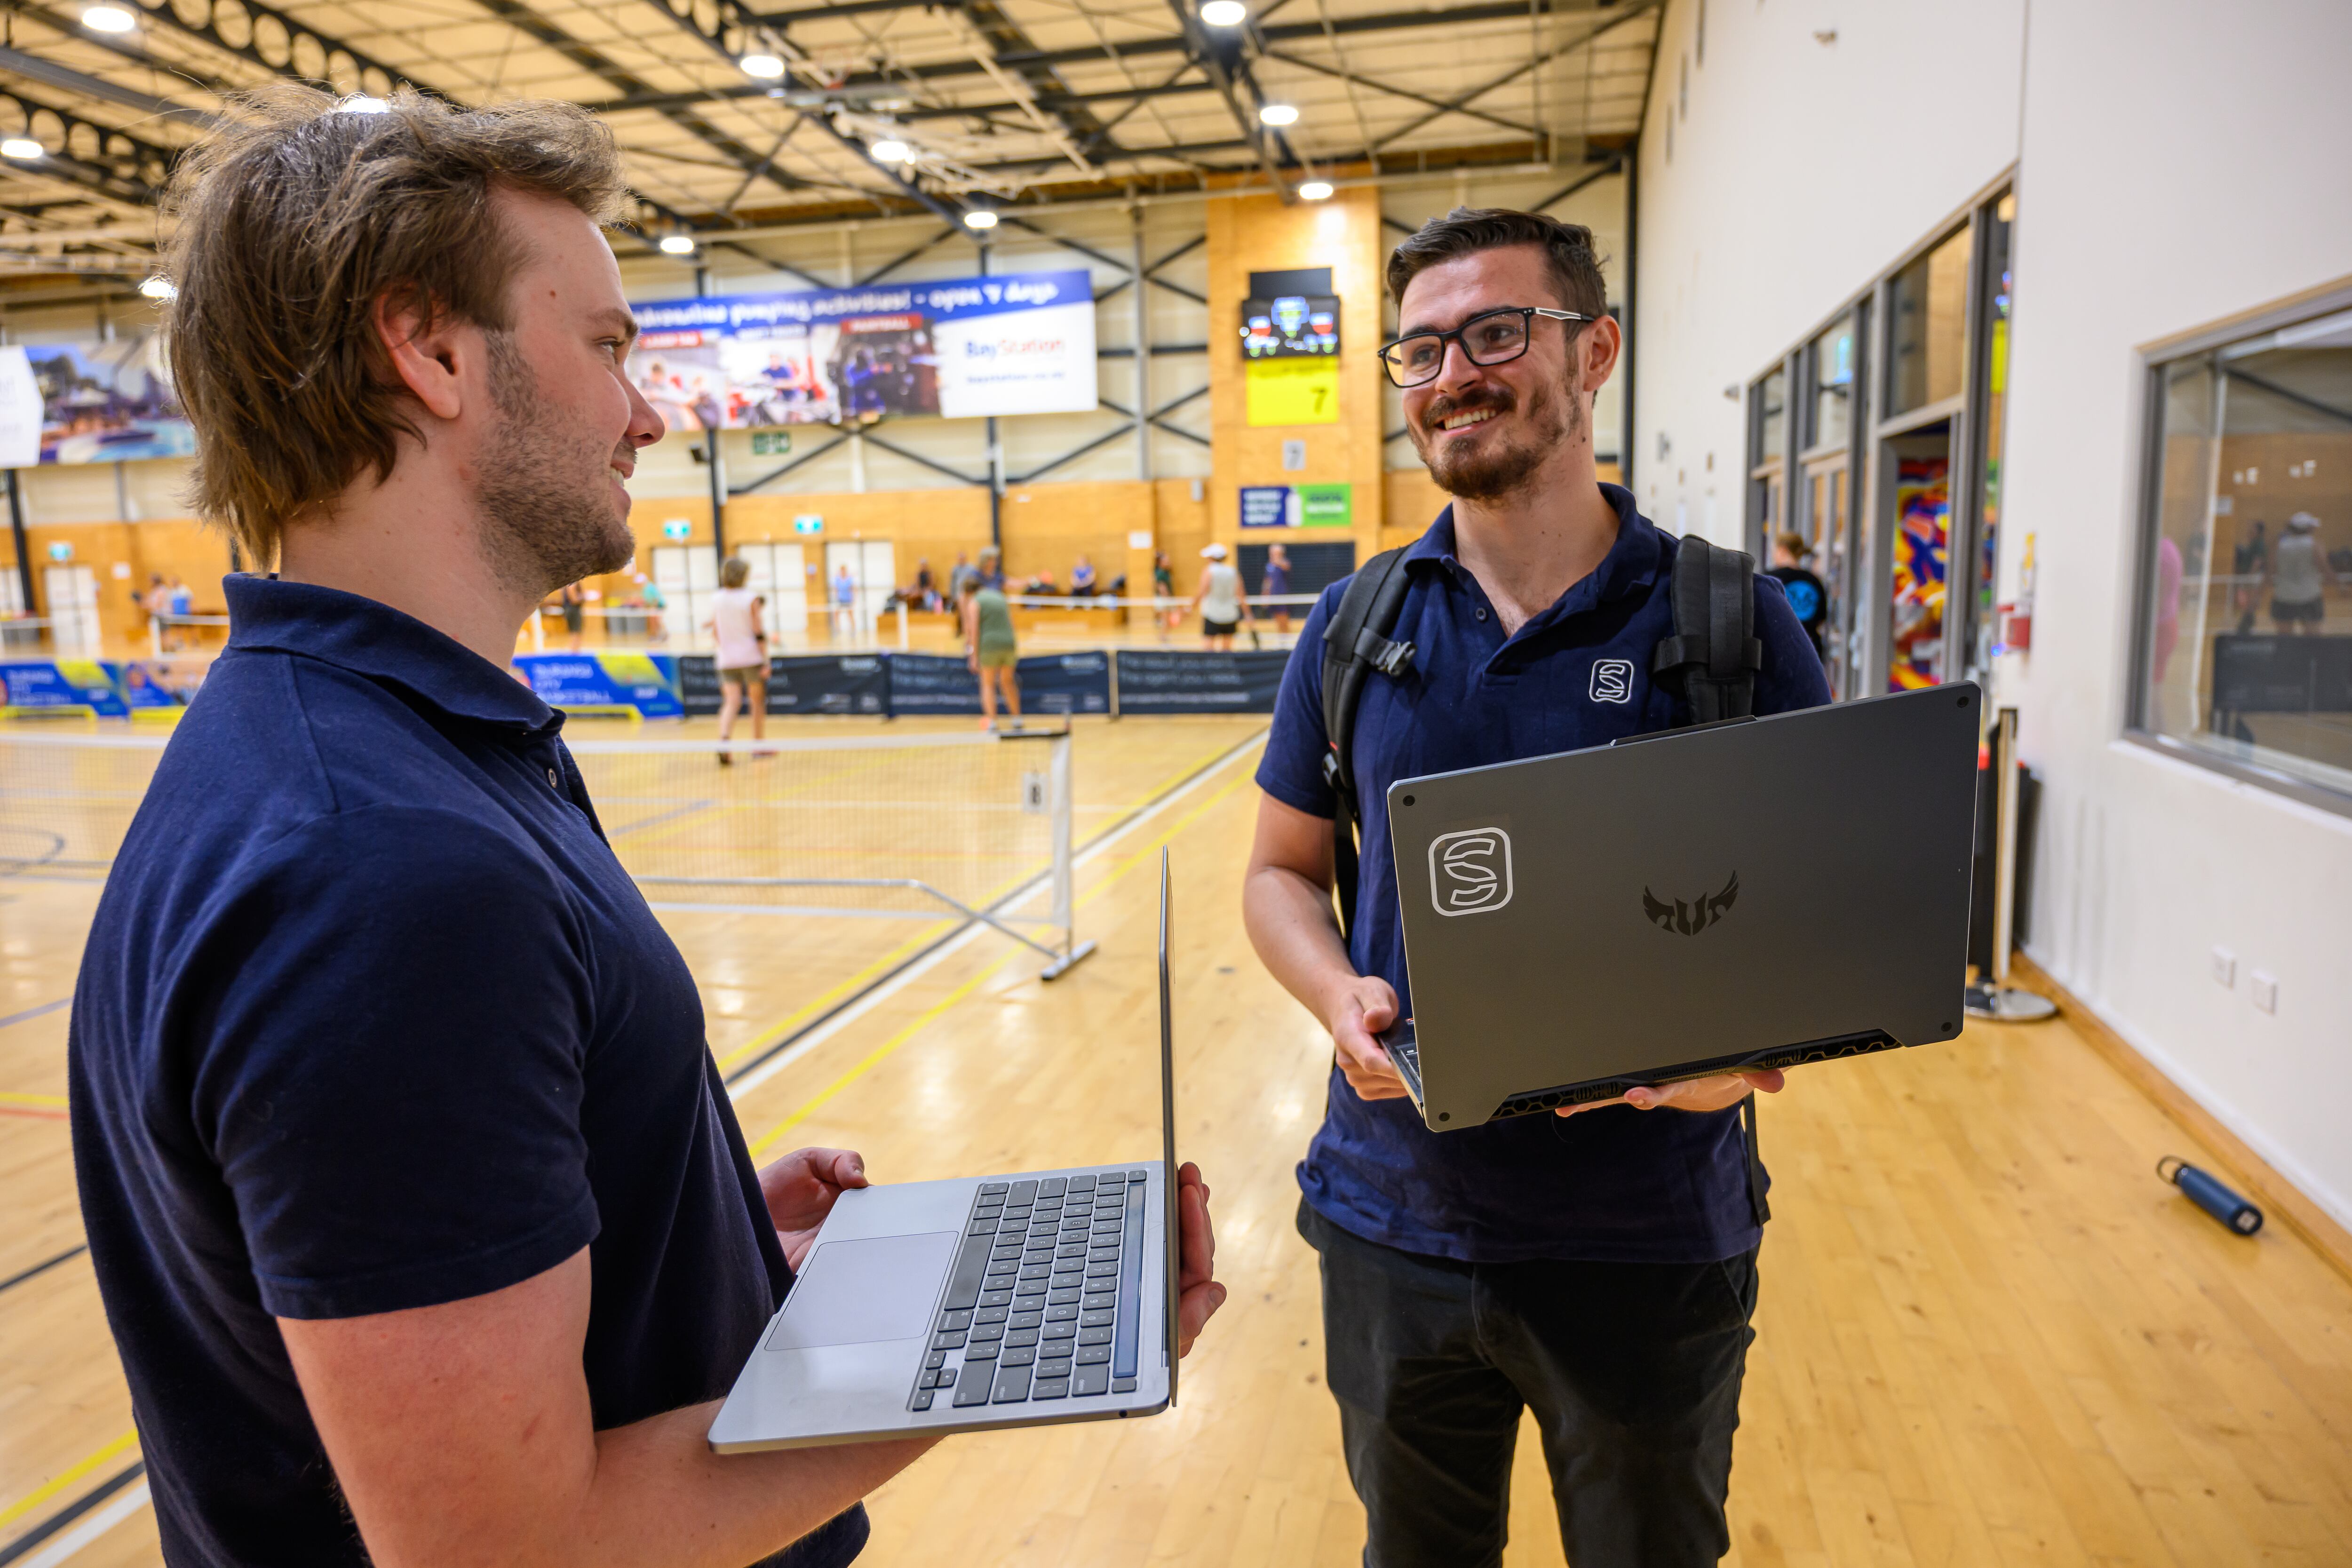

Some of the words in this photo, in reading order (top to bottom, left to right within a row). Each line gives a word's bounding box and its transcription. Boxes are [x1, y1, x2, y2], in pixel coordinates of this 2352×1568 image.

[928, 286, 984, 313] open
[1003, 281, 1059, 305] days
[1310, 386, 1328, 415] 7
